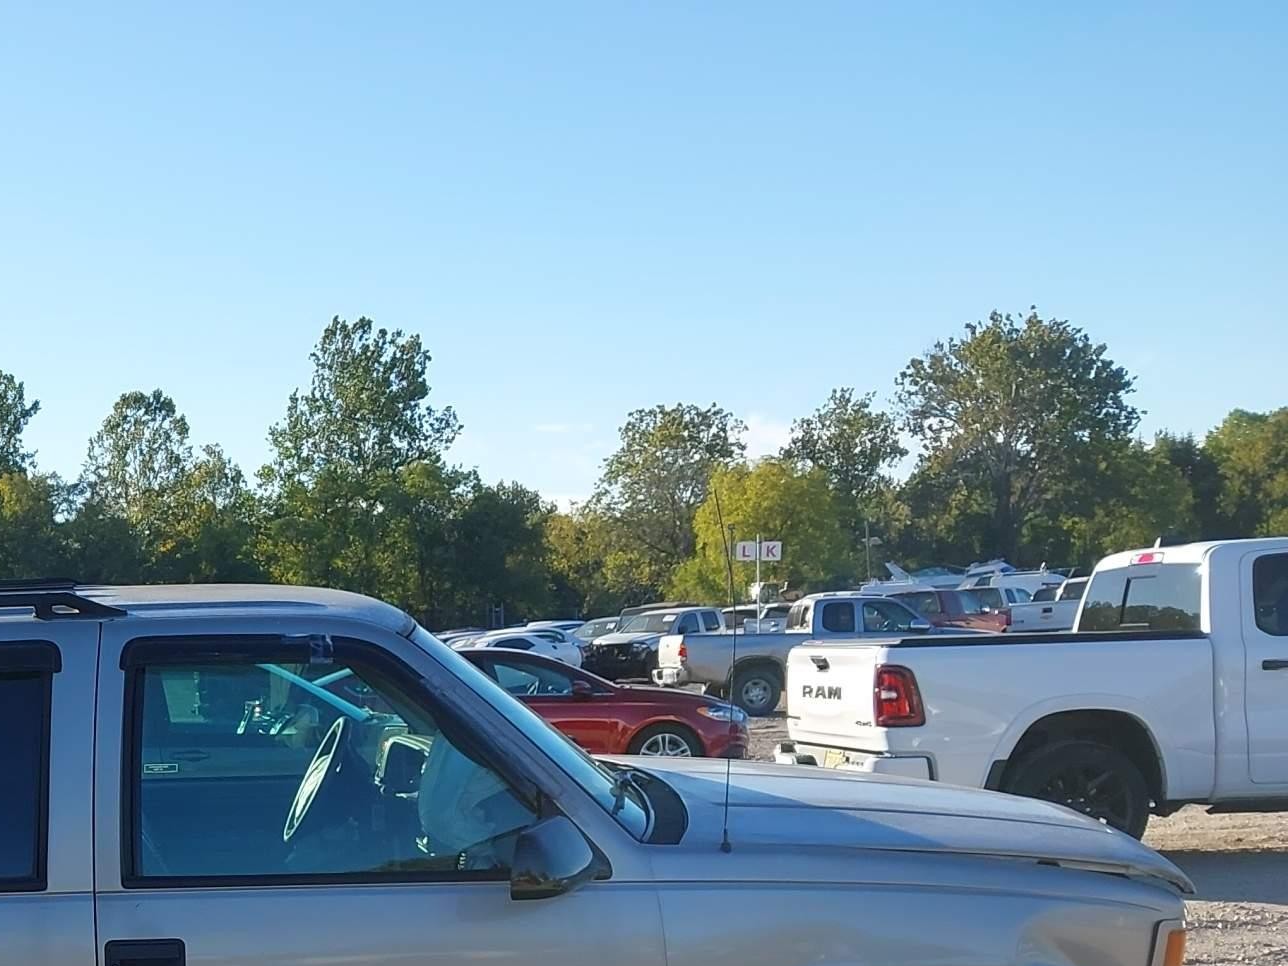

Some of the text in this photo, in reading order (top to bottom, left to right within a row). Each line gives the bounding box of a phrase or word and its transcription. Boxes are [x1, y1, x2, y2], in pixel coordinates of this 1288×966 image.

[742, 545, 751, 557] L
[766, 545, 776, 557] K
[802, 685, 842, 700] RAM
